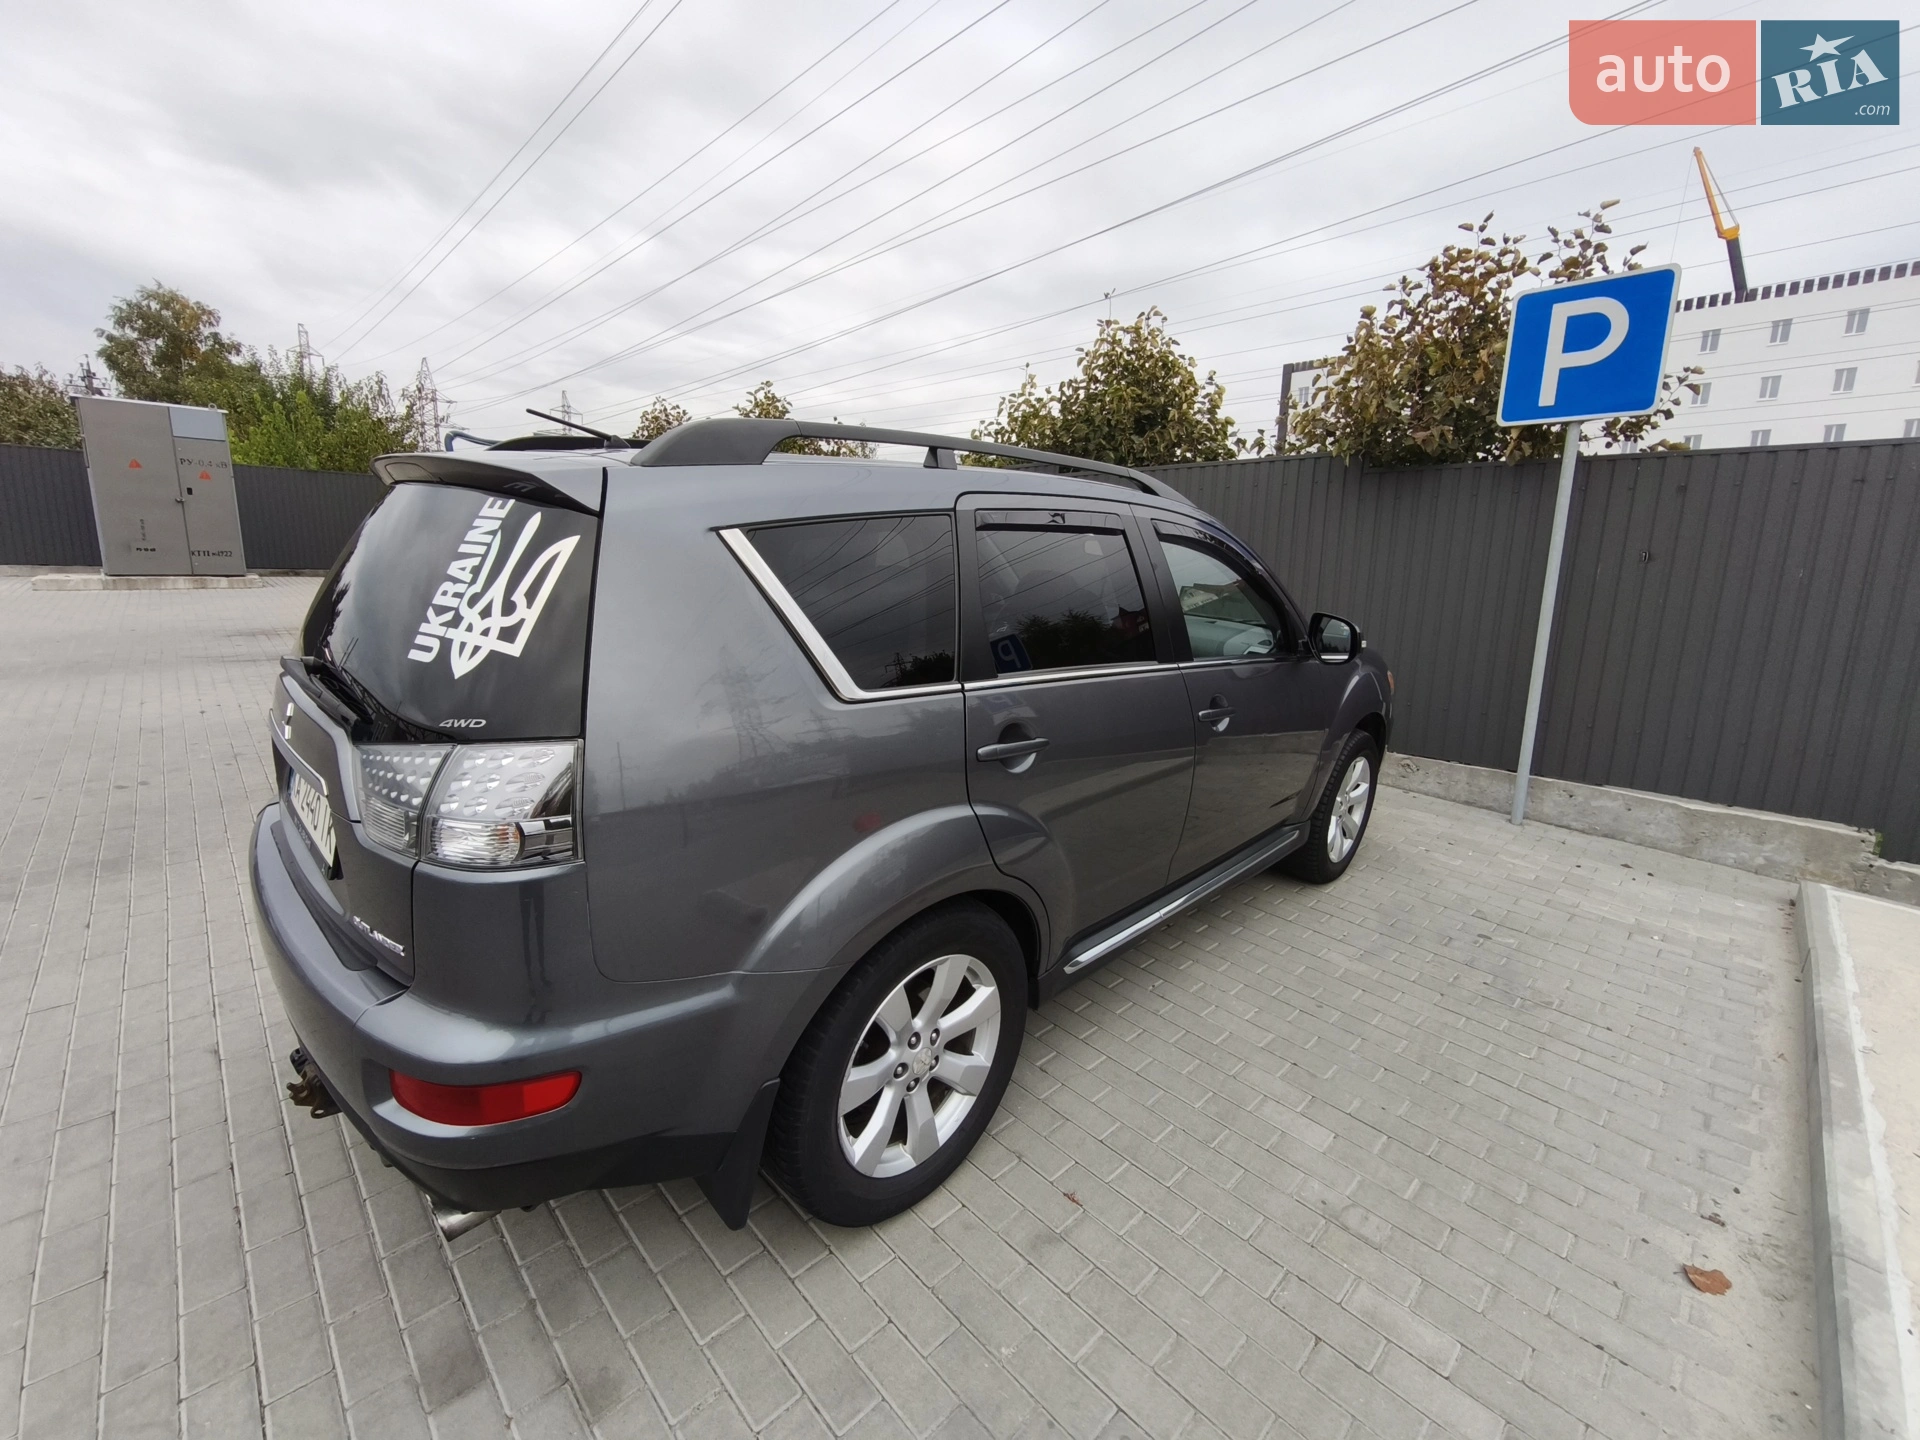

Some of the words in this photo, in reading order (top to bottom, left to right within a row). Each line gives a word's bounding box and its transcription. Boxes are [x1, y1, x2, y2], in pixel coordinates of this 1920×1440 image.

[1537, 296, 1630, 407] P
[407, 497, 516, 663] UKRAINE
[438, 718, 487, 728] 4WD
